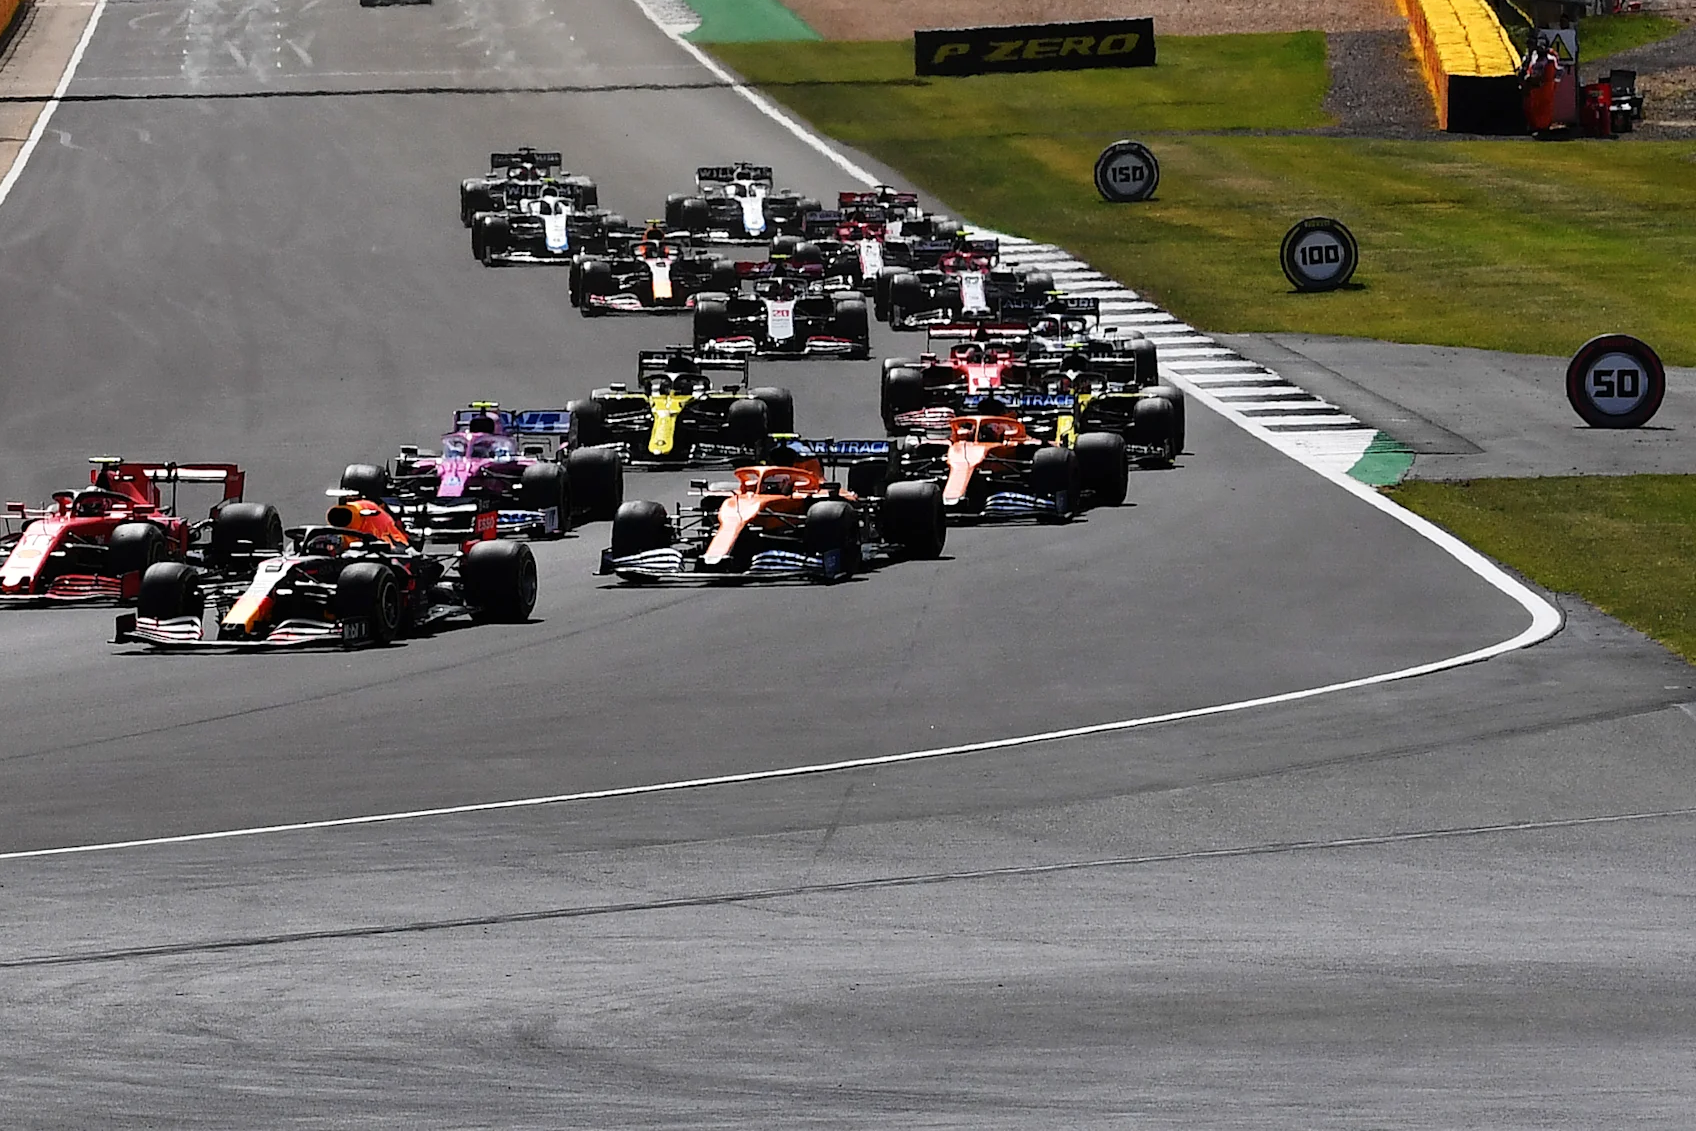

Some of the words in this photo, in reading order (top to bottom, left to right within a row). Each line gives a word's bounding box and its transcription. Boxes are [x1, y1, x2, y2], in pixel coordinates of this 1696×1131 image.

[932, 42, 971, 65] P
[984, 32, 1141, 63] ZERO
[1112, 166, 1144, 182] 150
[1301, 245, 1339, 265] 100
[1593, 369, 1639, 398] 50
